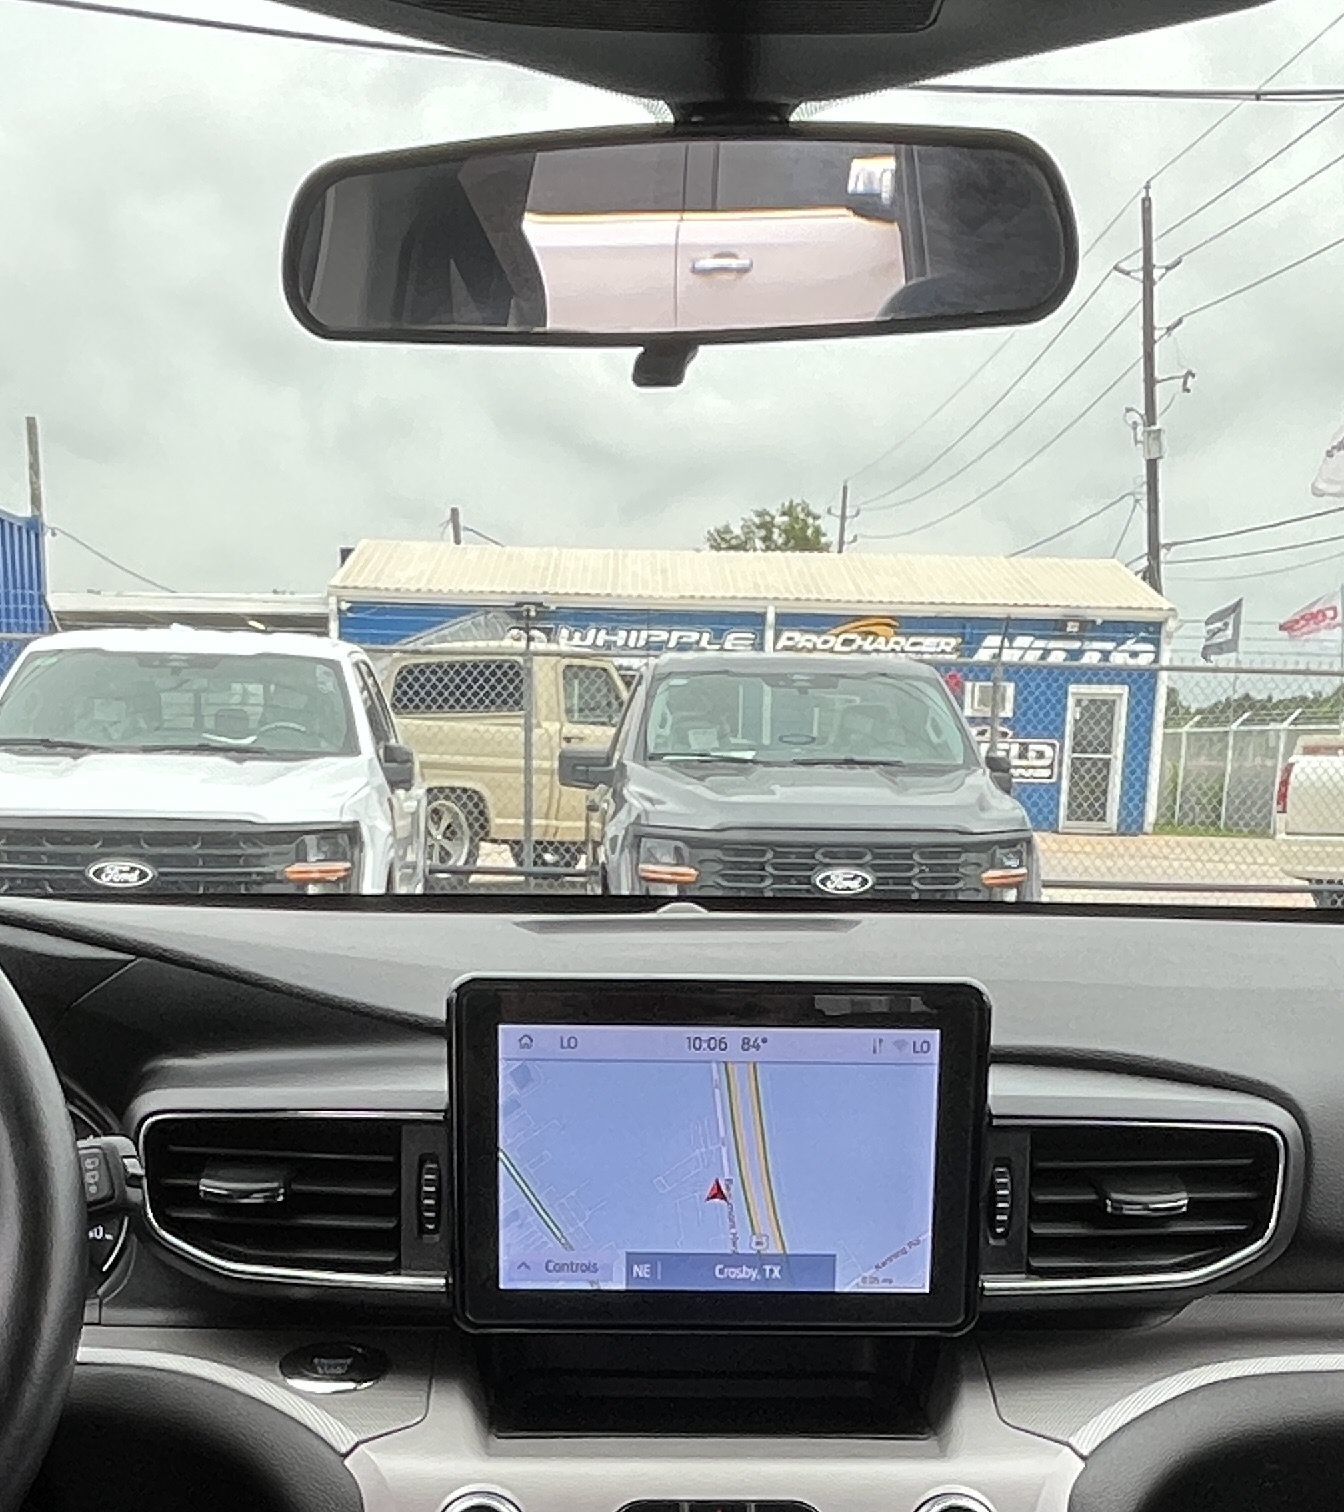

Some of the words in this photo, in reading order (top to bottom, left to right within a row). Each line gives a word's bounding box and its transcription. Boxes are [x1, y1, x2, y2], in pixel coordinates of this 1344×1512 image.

[558, 626, 756, 650] WHIPPLE
[972, 635, 1156, 665] NITTO
[559, 1036, 578, 1050] LO
[685, 1035, 728, 1052] 10:06
[740, 1035, 768, 1052] 84°
[912, 1040, 931, 1055] LO
[544, 1259, 599, 1274] Controls
[632, 1264, 651, 1278] NE
[714, 1264, 760, 1281] Crosby,
[763, 1264, 782, 1279] TX
